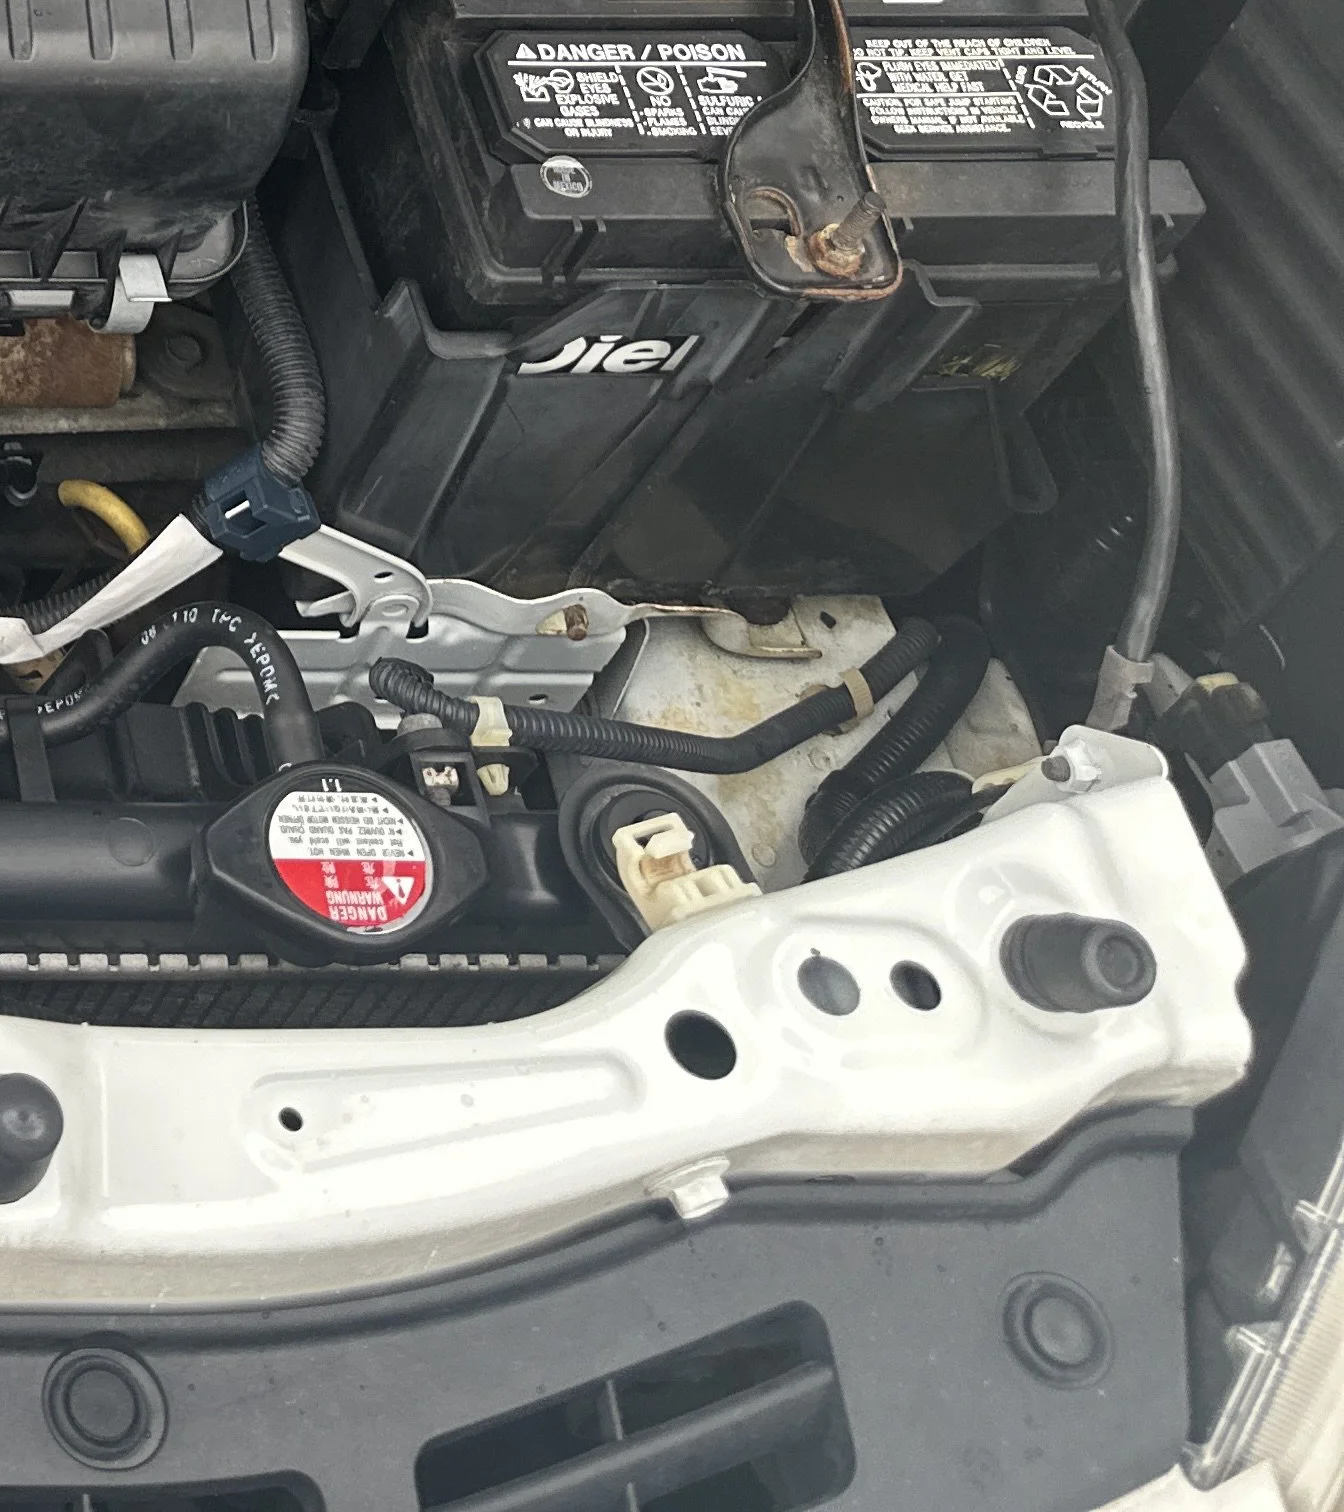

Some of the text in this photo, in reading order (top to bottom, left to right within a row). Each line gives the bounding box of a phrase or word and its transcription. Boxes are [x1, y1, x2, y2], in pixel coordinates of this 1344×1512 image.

[536, 43, 747, 61] DANGER / POISON
[575, 72, 619, 83] SHIELD
[949, 71, 969, 81] GET
[579, 83, 612, 94] EYES
[554, 93, 621, 105] EXPLOSIVE
[649, 95, 672, 107] NO
[697, 95, 755, 107] SULFURIC
[183, 607, 199, 624] 10
[329, 848, 350, 857] WHEN
[357, 848, 377, 857] OPEN
[325, 891, 385, 906] WARNUNG
[329, 906, 389, 922] DANGER
